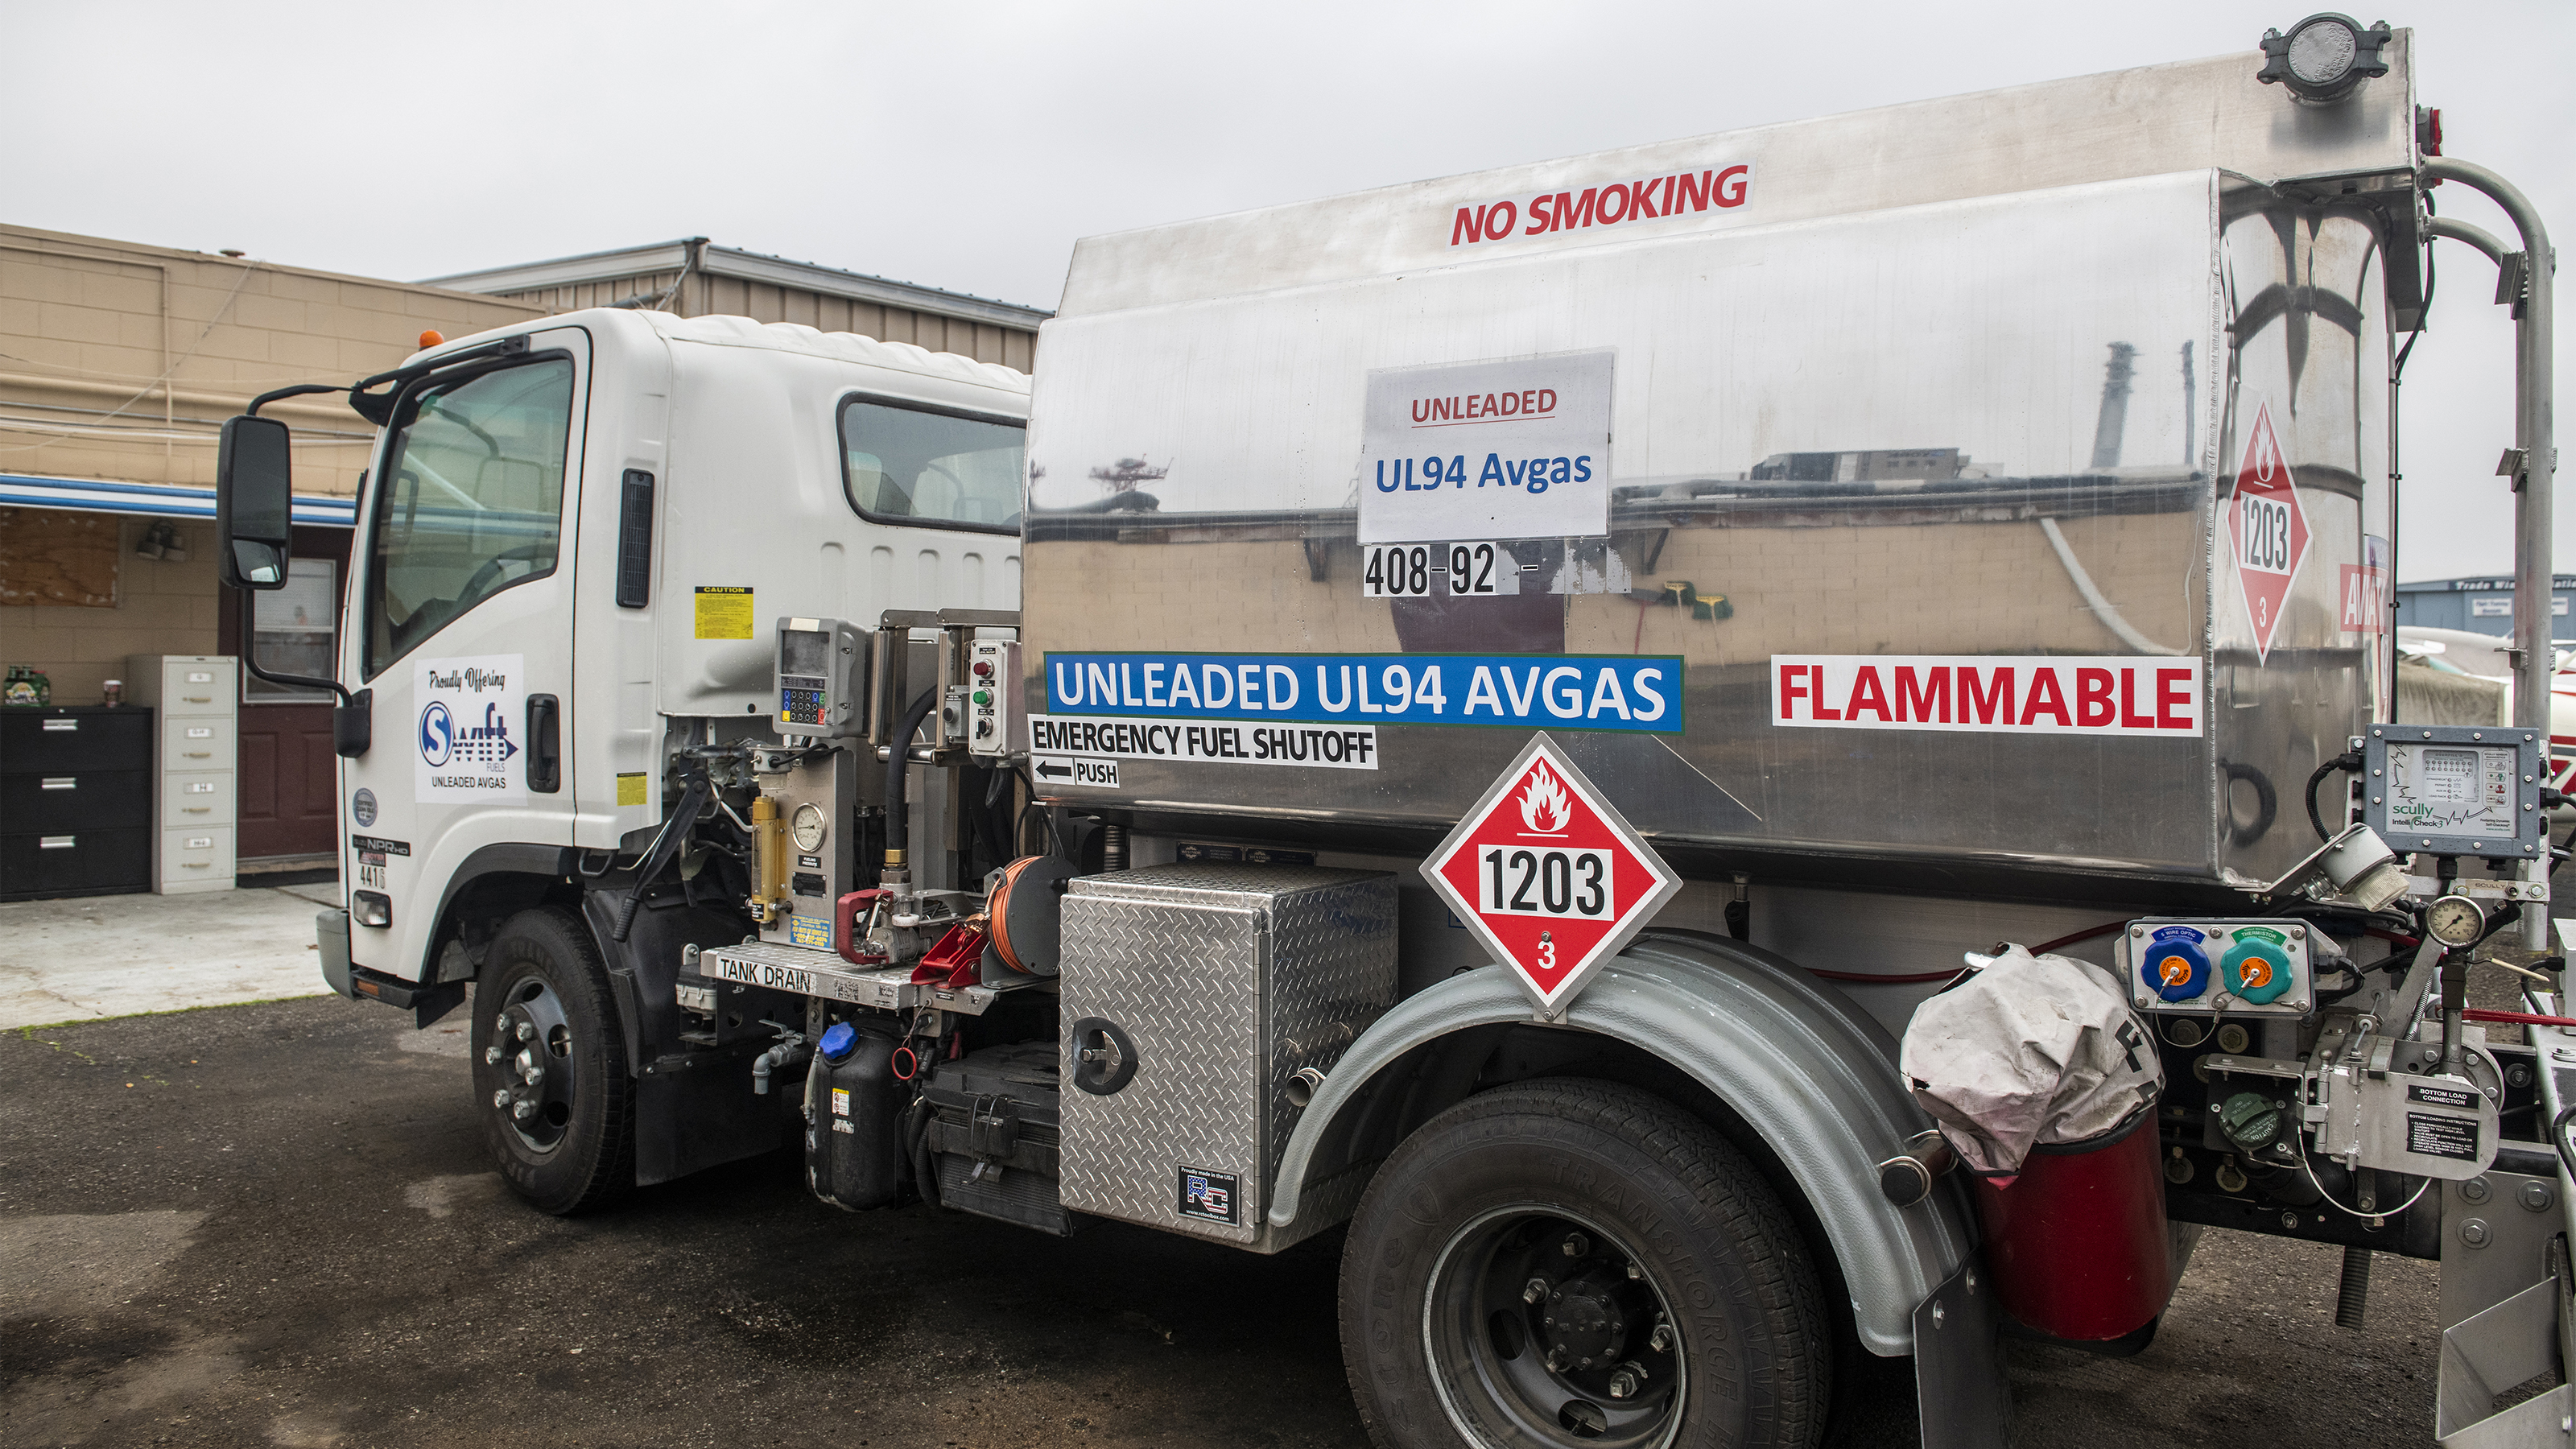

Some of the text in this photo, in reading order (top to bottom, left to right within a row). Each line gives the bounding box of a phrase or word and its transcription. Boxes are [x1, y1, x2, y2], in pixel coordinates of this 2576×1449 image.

[1451, 165, 1748, 246] NO SMOKING
[1411, 389, 1557, 423] UNLEADED
[1377, 453, 1591, 493] UL94 Avgas
[2243, 497, 2287, 570] 1203
[2456, 580, 2491, 590] Trade
[2259, 597, 2267, 627] 3
[429, 667, 506, 693] Proudly Offering
[1055, 663, 1666, 721] UNLEADED UL94 AVGAS
[1780, 665, 2193, 729] FLAMMABLE
[1032, 720, 1373, 763] EMERGENCY FUEL SHUTOFF
[486, 762, 506, 773] FUELS
[1078, 763, 1118, 784] PUSH
[431, 776, 506, 789] UNLEADED AVGAS
[2392, 803, 2434, 818] scully
[367, 838, 394, 852] NPR
[1485, 848, 1605, 916] 1203
[2180, 930, 2196, 938] OPTIC
[2240, 930, 2277, 939] THERMISTOR
[1538, 939, 1556, 969] 3
[720, 958, 811, 993] TANK DRAIN
[2174, 968, 2189, 984] scully
[2419, 1088, 2467, 1100] BOTTOM LOAD
[2422, 1095, 2466, 1105] CONNECTION
[2250, 1124, 2274, 1140] CAUTION
[1181, 1166, 1198, 1175] Proudly
[1187, 1174, 1228, 1214] RC
[1186, 1210, 1230, 1221] www.rctoolbox.com
[1550, 1157, 1737, 1402] TRANSFORCE
